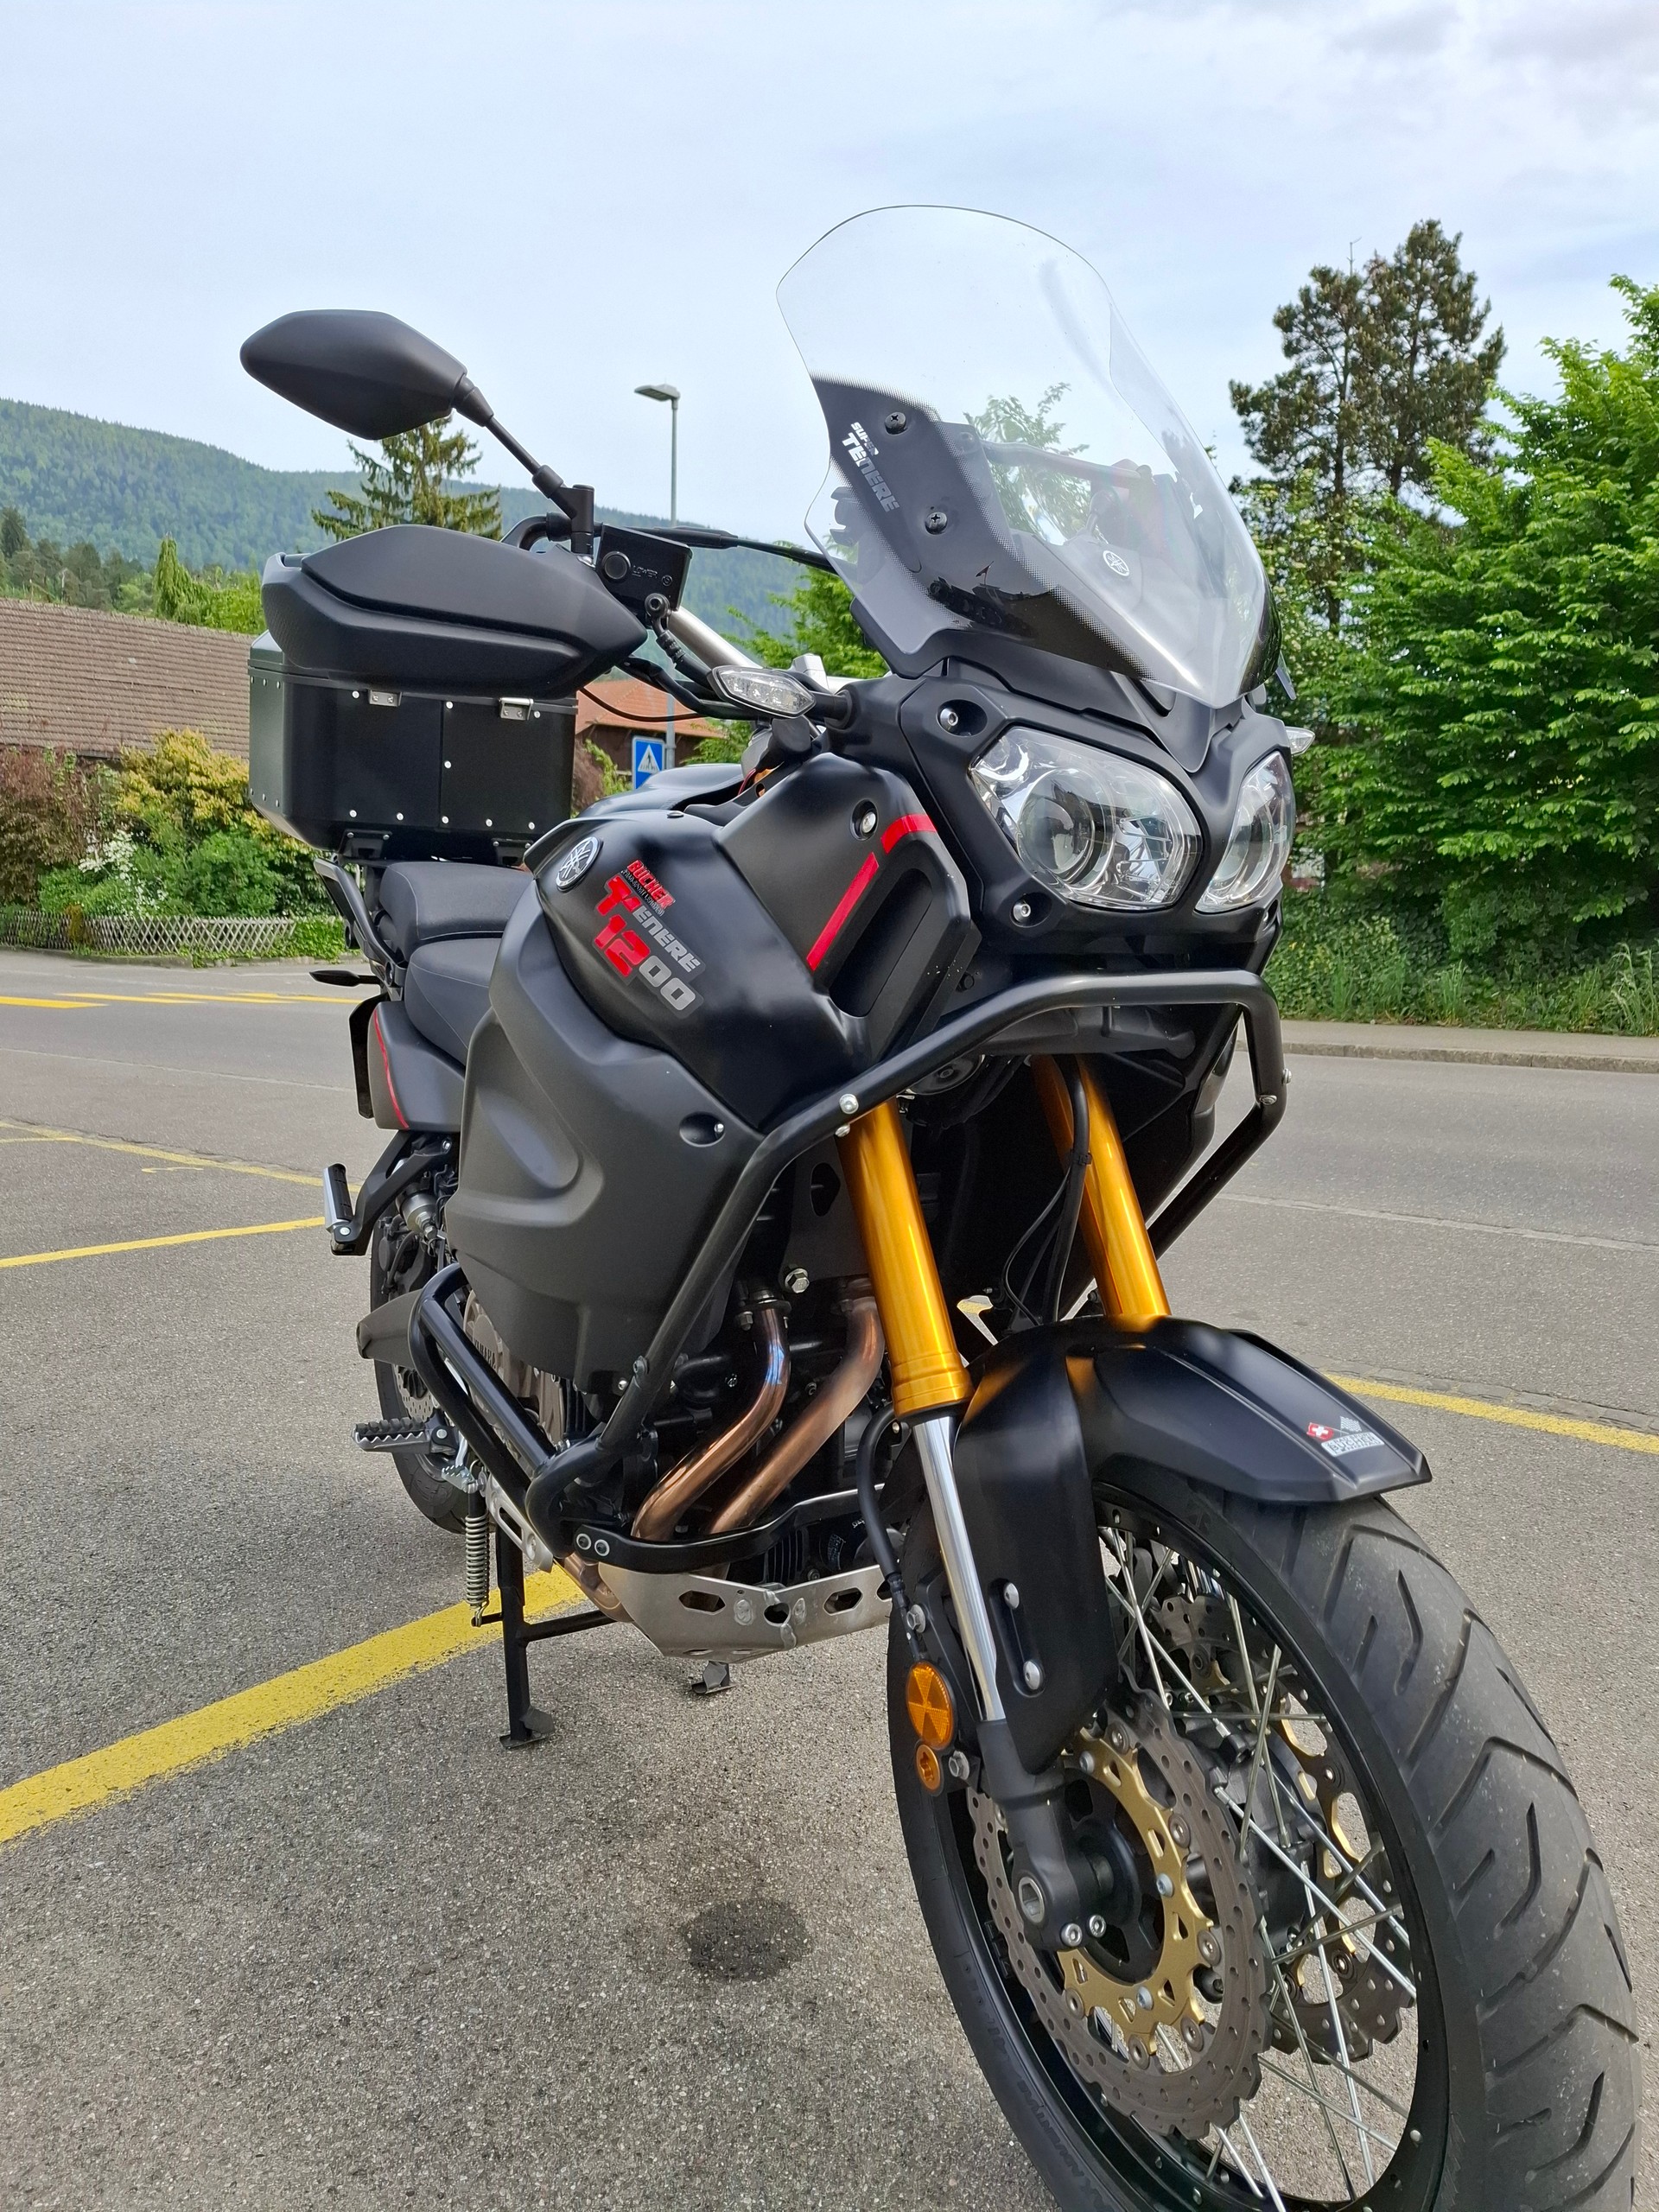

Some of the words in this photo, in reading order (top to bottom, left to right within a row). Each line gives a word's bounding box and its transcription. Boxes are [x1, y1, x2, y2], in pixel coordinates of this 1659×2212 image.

[850, 422, 880, 456] SUPER
[626, 859, 676, 910] BUCHER
[595, 915, 696, 1010] 1200
